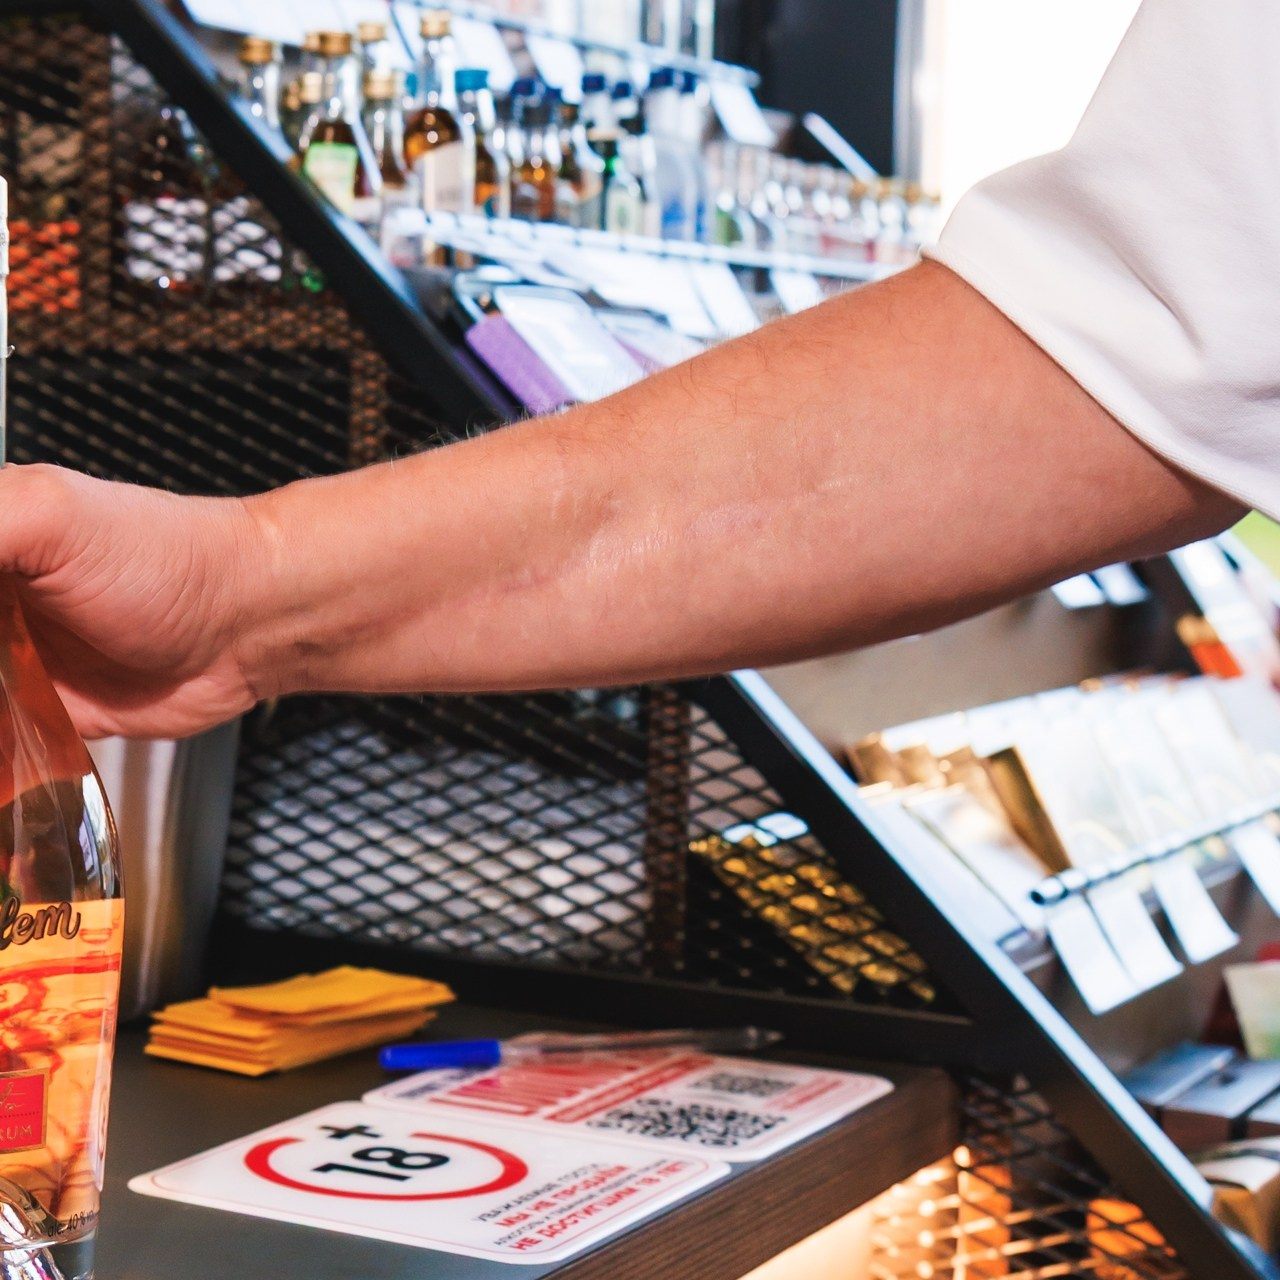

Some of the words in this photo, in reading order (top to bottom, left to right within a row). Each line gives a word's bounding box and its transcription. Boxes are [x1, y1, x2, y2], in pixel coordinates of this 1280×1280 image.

[494, 1211, 531, 1228] МЫ
[530, 1199, 557, 1213] НЕ
[508, 1236, 543, 1251] НЕ
